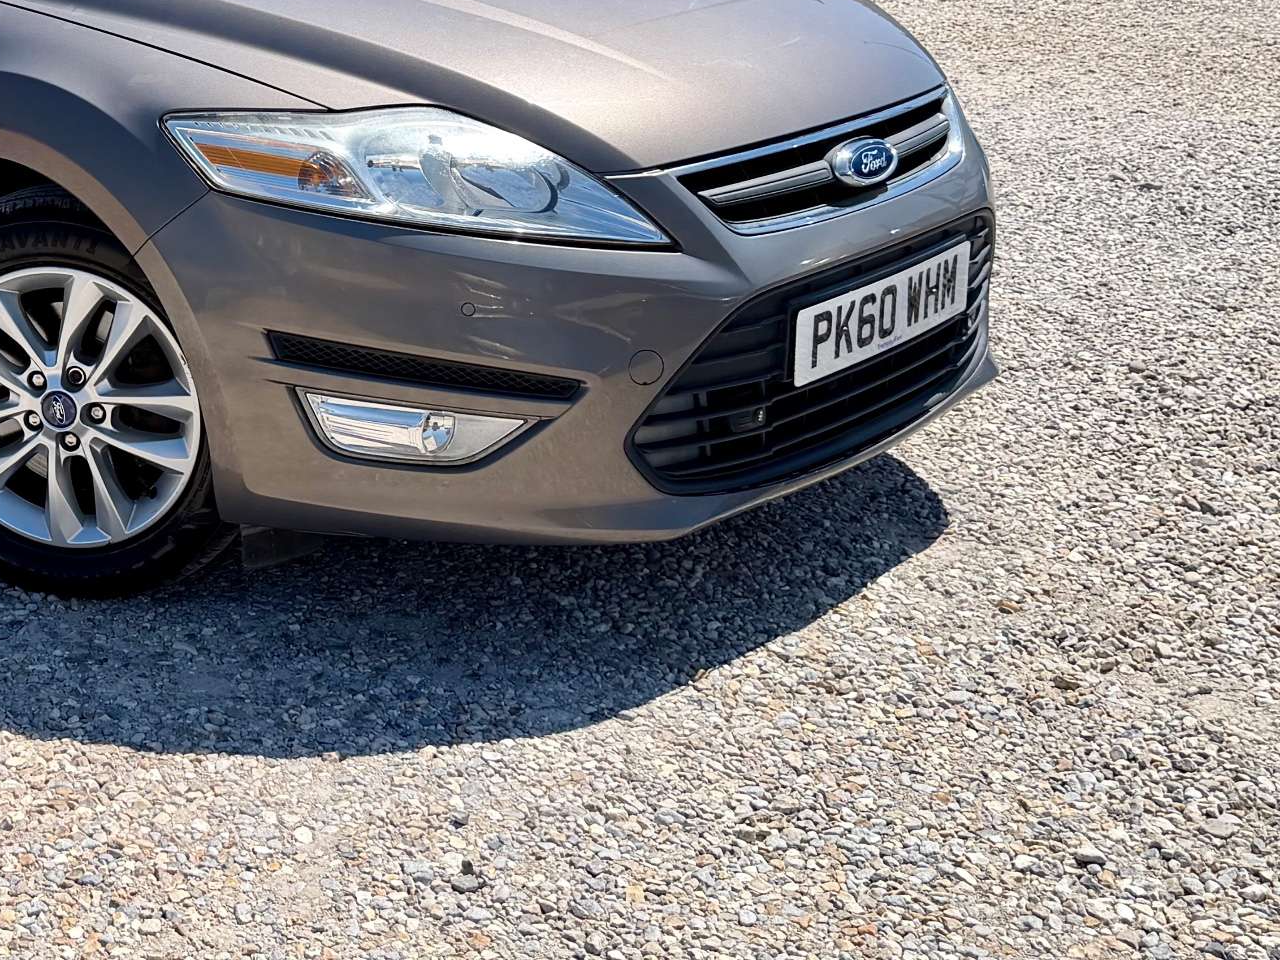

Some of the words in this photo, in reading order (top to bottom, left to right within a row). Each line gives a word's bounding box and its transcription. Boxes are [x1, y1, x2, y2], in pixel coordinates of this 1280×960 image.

[861, 149, 888, 174] Ford
[811, 284, 898, 370] PK60
[907, 254, 958, 329] WHM
